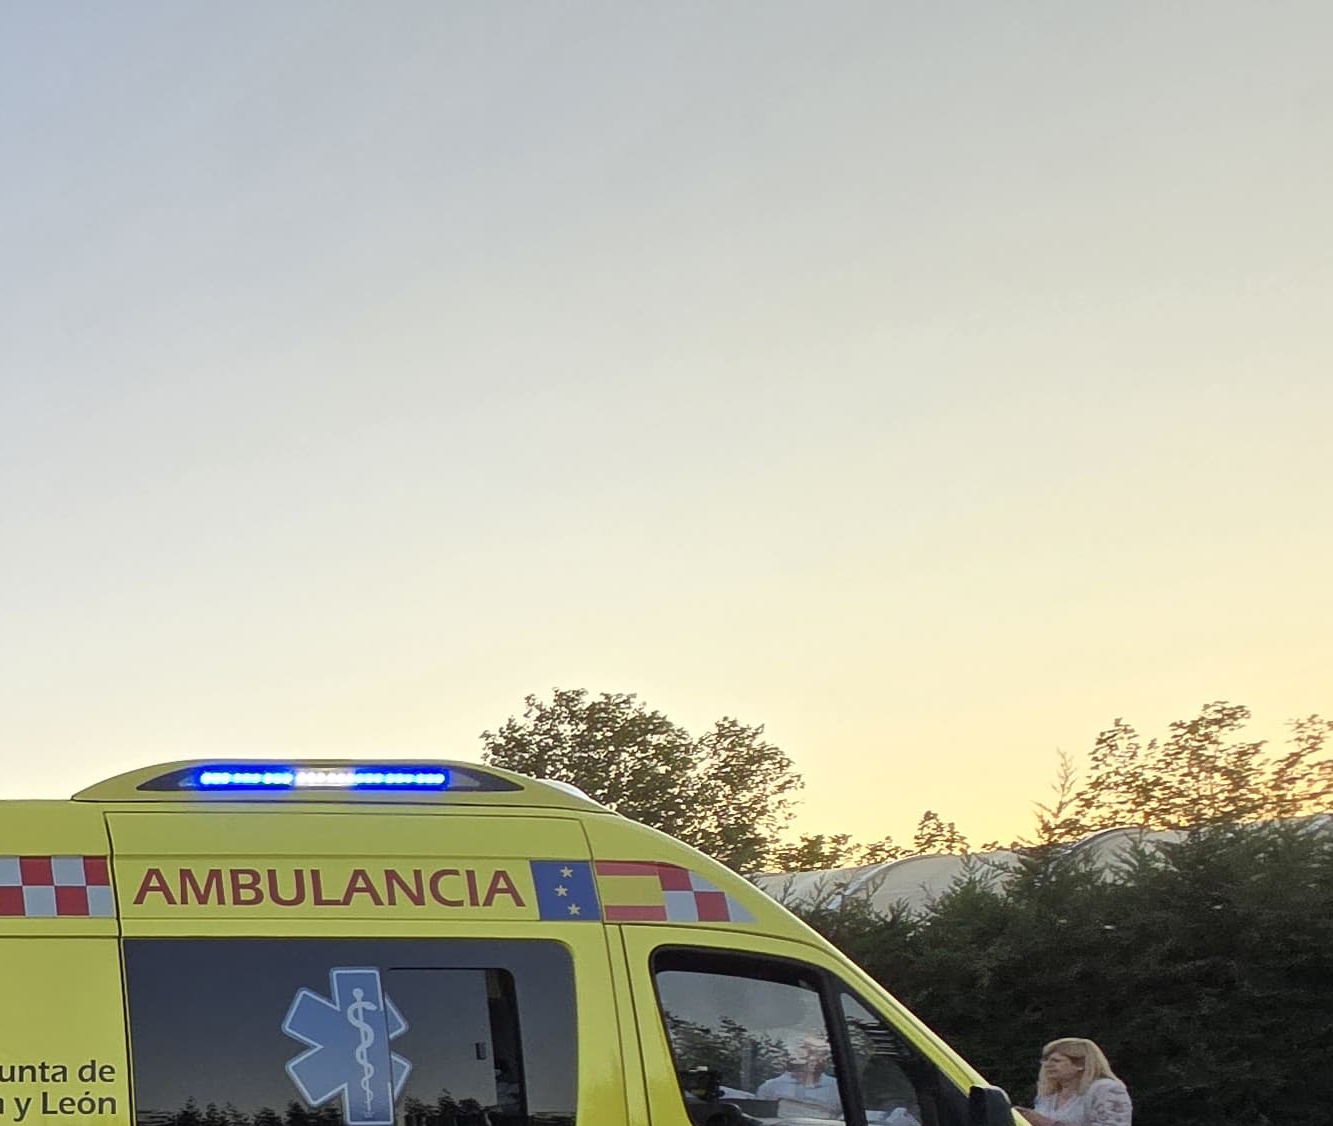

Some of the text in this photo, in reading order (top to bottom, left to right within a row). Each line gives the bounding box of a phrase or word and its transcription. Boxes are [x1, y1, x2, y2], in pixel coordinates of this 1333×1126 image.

[132, 868, 526, 907] AMBULANCIA
[78, 1060, 116, 1083] de
[13, 1097, 32, 1122] y
[42, 1091, 117, 1115] León
